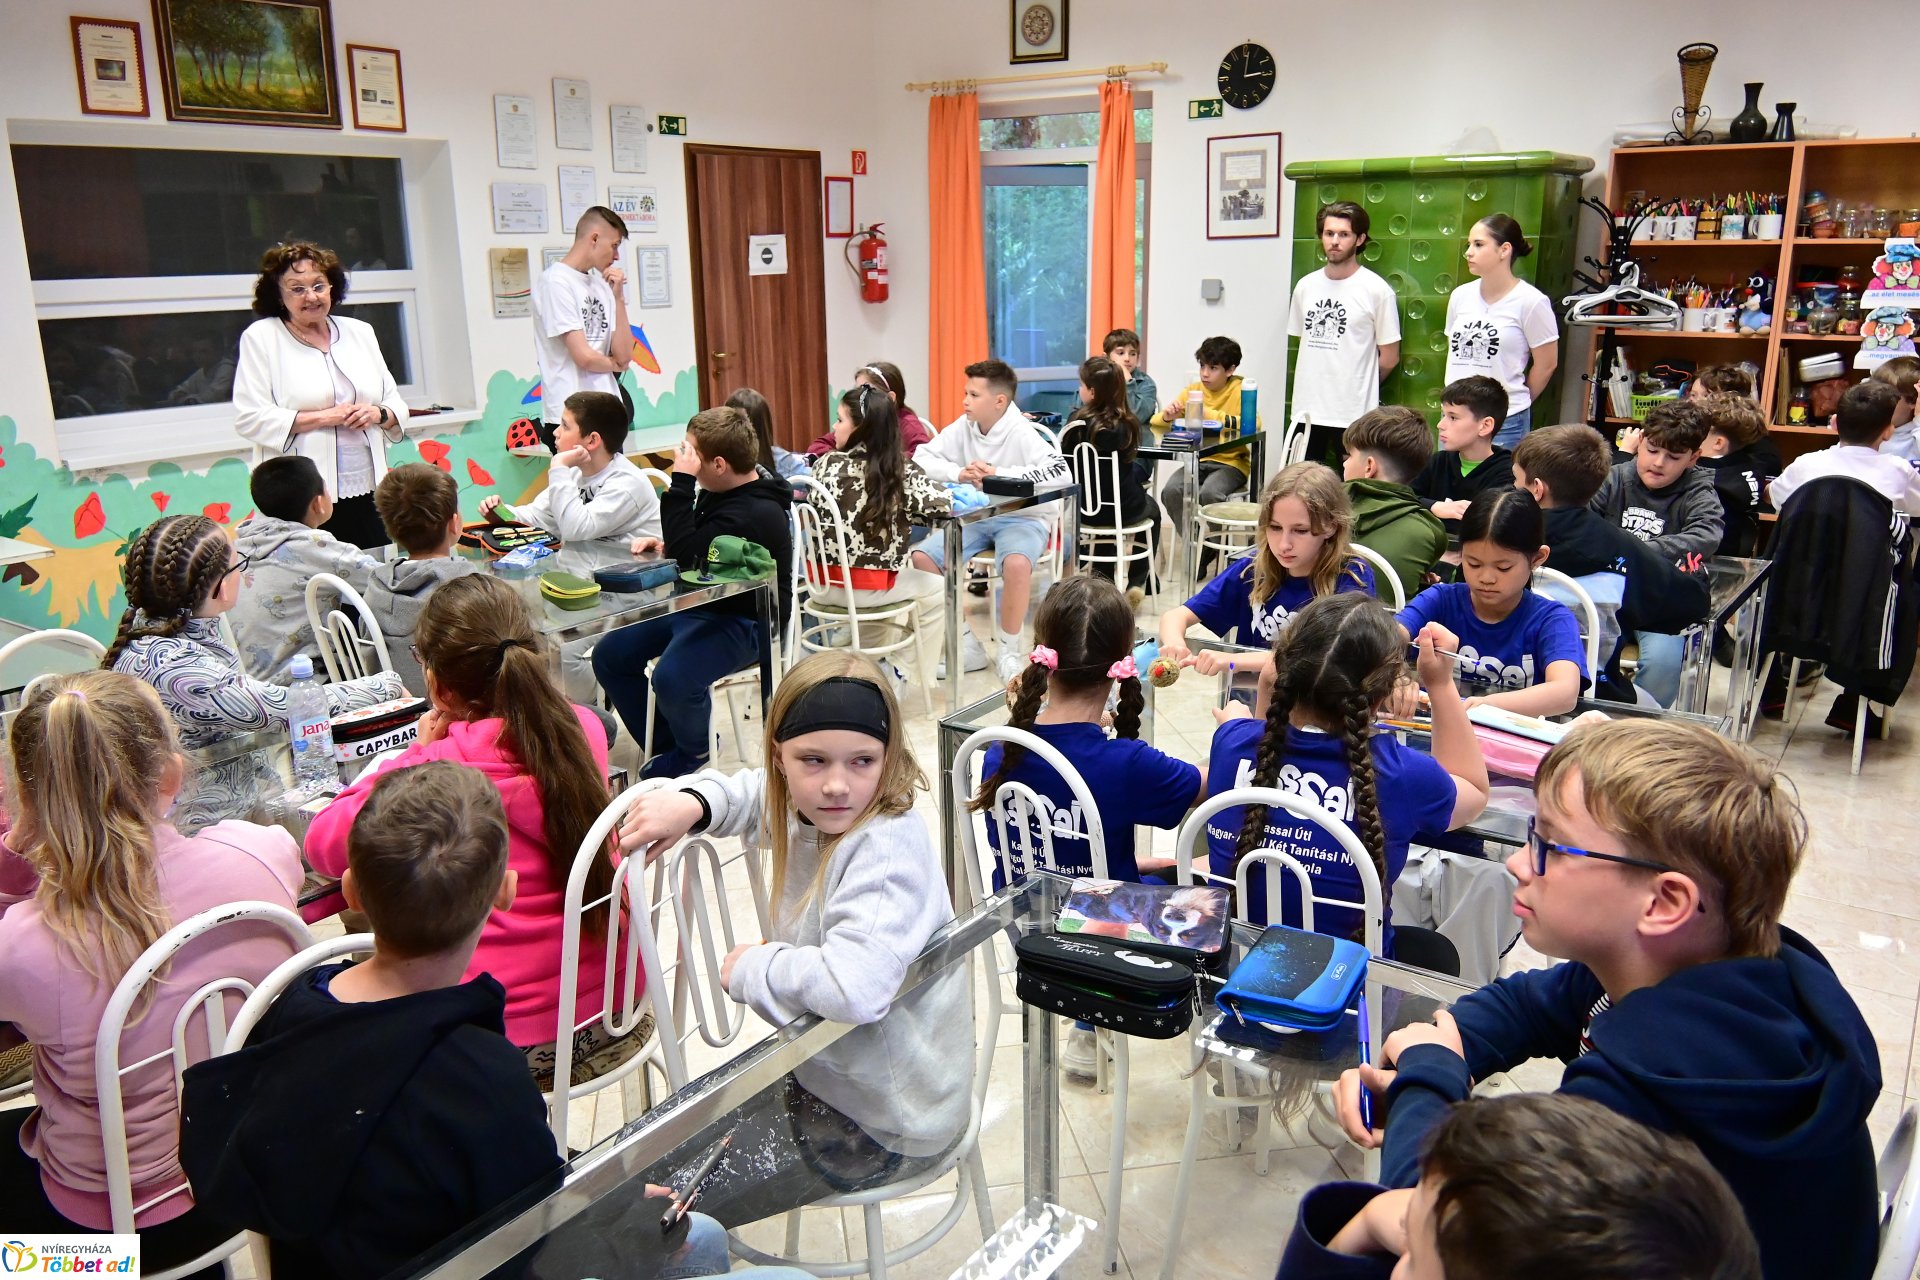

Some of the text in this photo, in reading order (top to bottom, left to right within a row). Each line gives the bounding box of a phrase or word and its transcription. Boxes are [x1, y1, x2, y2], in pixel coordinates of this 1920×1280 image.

[613, 199, 637, 212] AZ ÉV
[1304, 298, 1348, 335] KIS VAKOND
[1451, 320, 1500, 356] KIS VAKOND
[1741, 470, 1760, 506] NEW
[1621, 511, 1665, 535] STARS
[1627, 507, 1656, 520] BRAWL
[301, 720, 330, 738] Jana
[355, 727, 418, 757] CAPYBAR
[1263, 823, 1312, 842] assai Úti
[1268, 838, 1288, 853] Két
[1289, 843, 1338, 861] Tanítási
